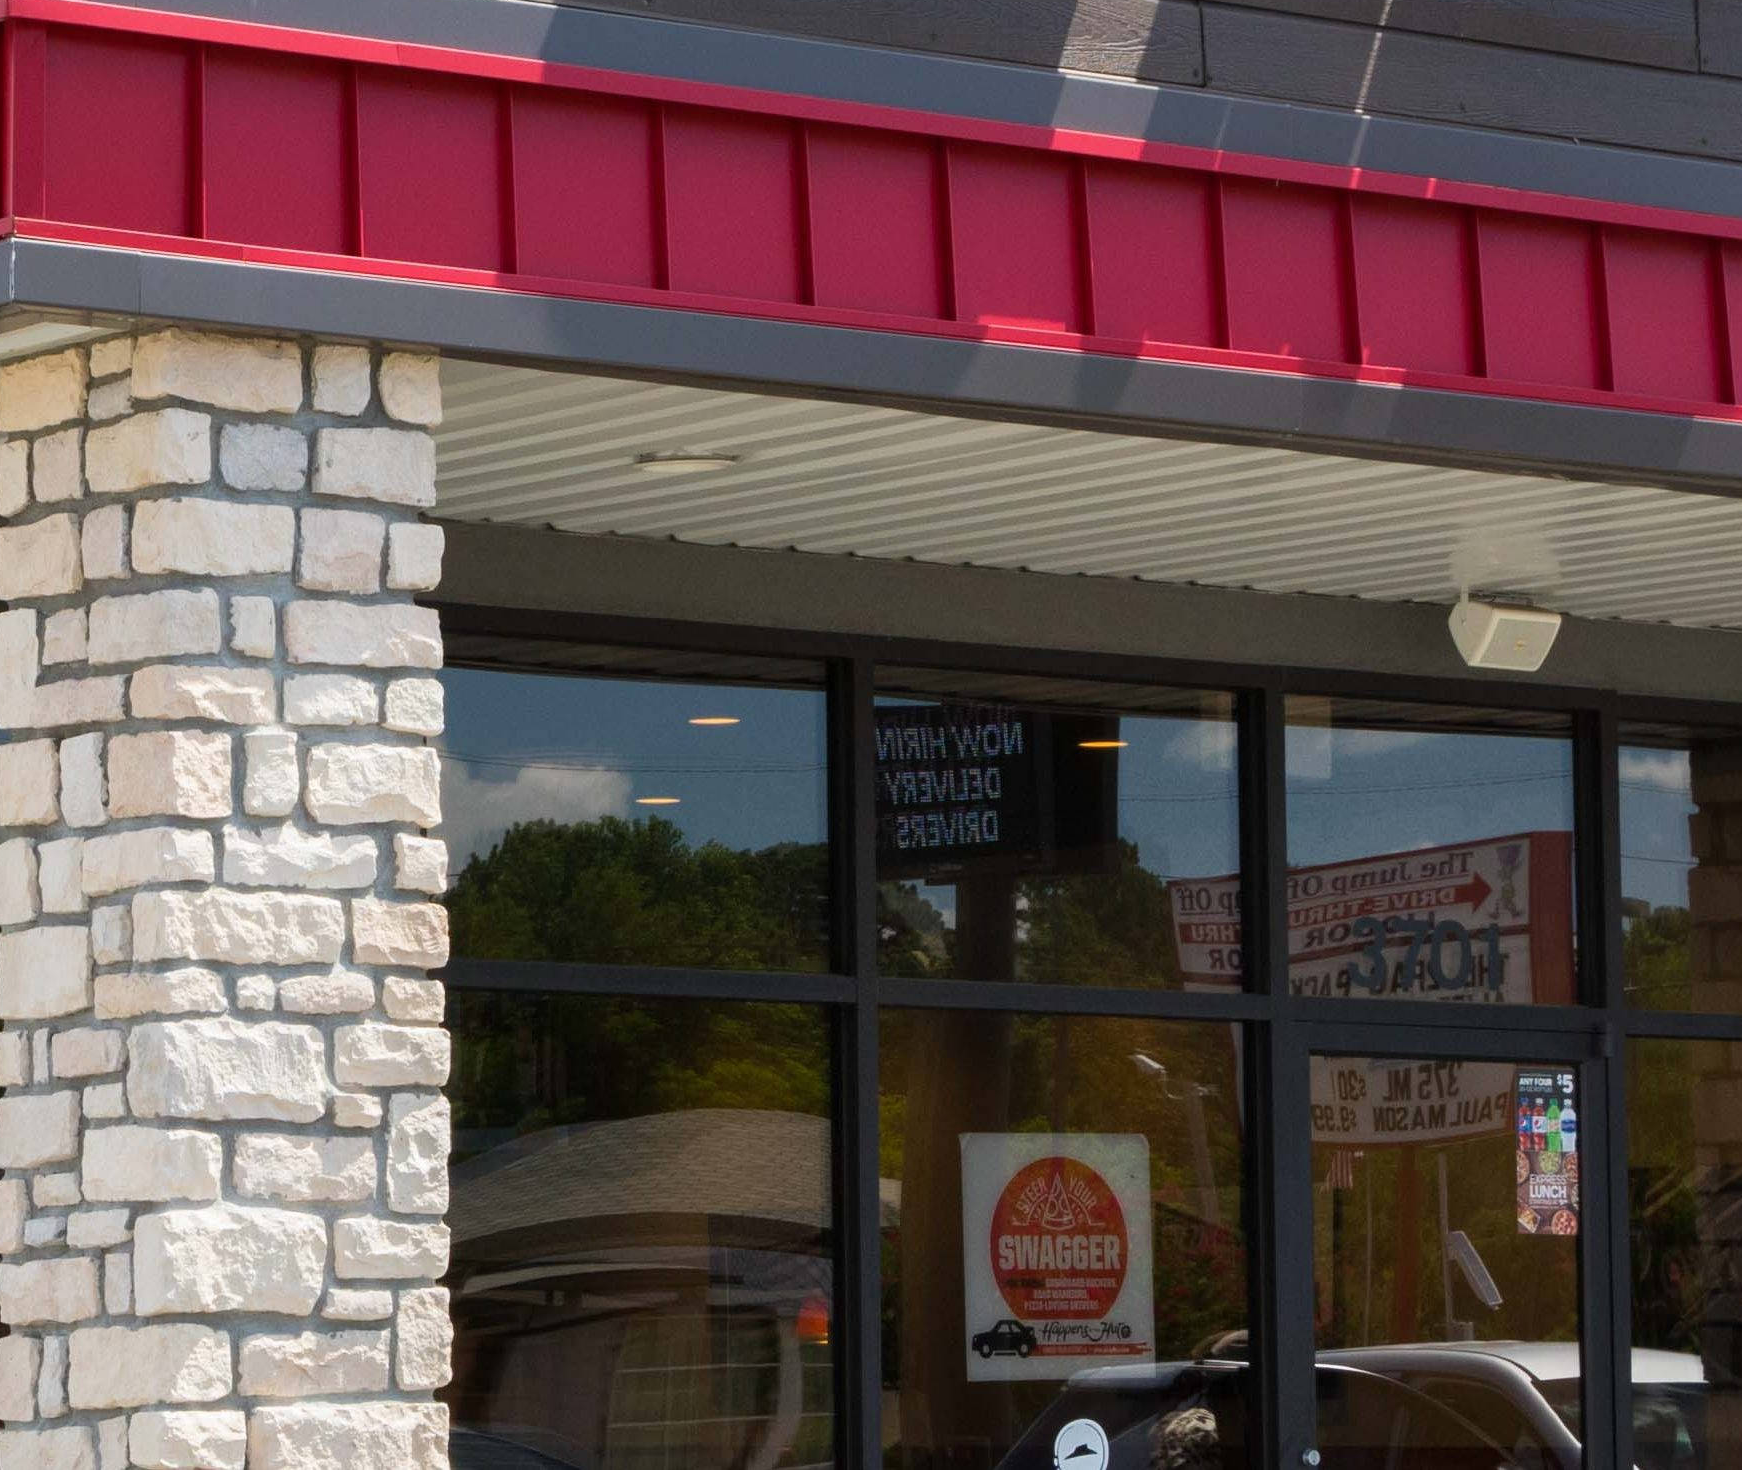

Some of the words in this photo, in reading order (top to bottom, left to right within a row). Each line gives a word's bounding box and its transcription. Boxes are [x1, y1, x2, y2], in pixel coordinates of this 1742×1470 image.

[1351, 916, 1501, 992] 3701
[1556, 1073, 1575, 1094] $5
[1529, 1185, 1567, 1199] LUNCH
[998, 1234, 1121, 1271] SWAGGER
